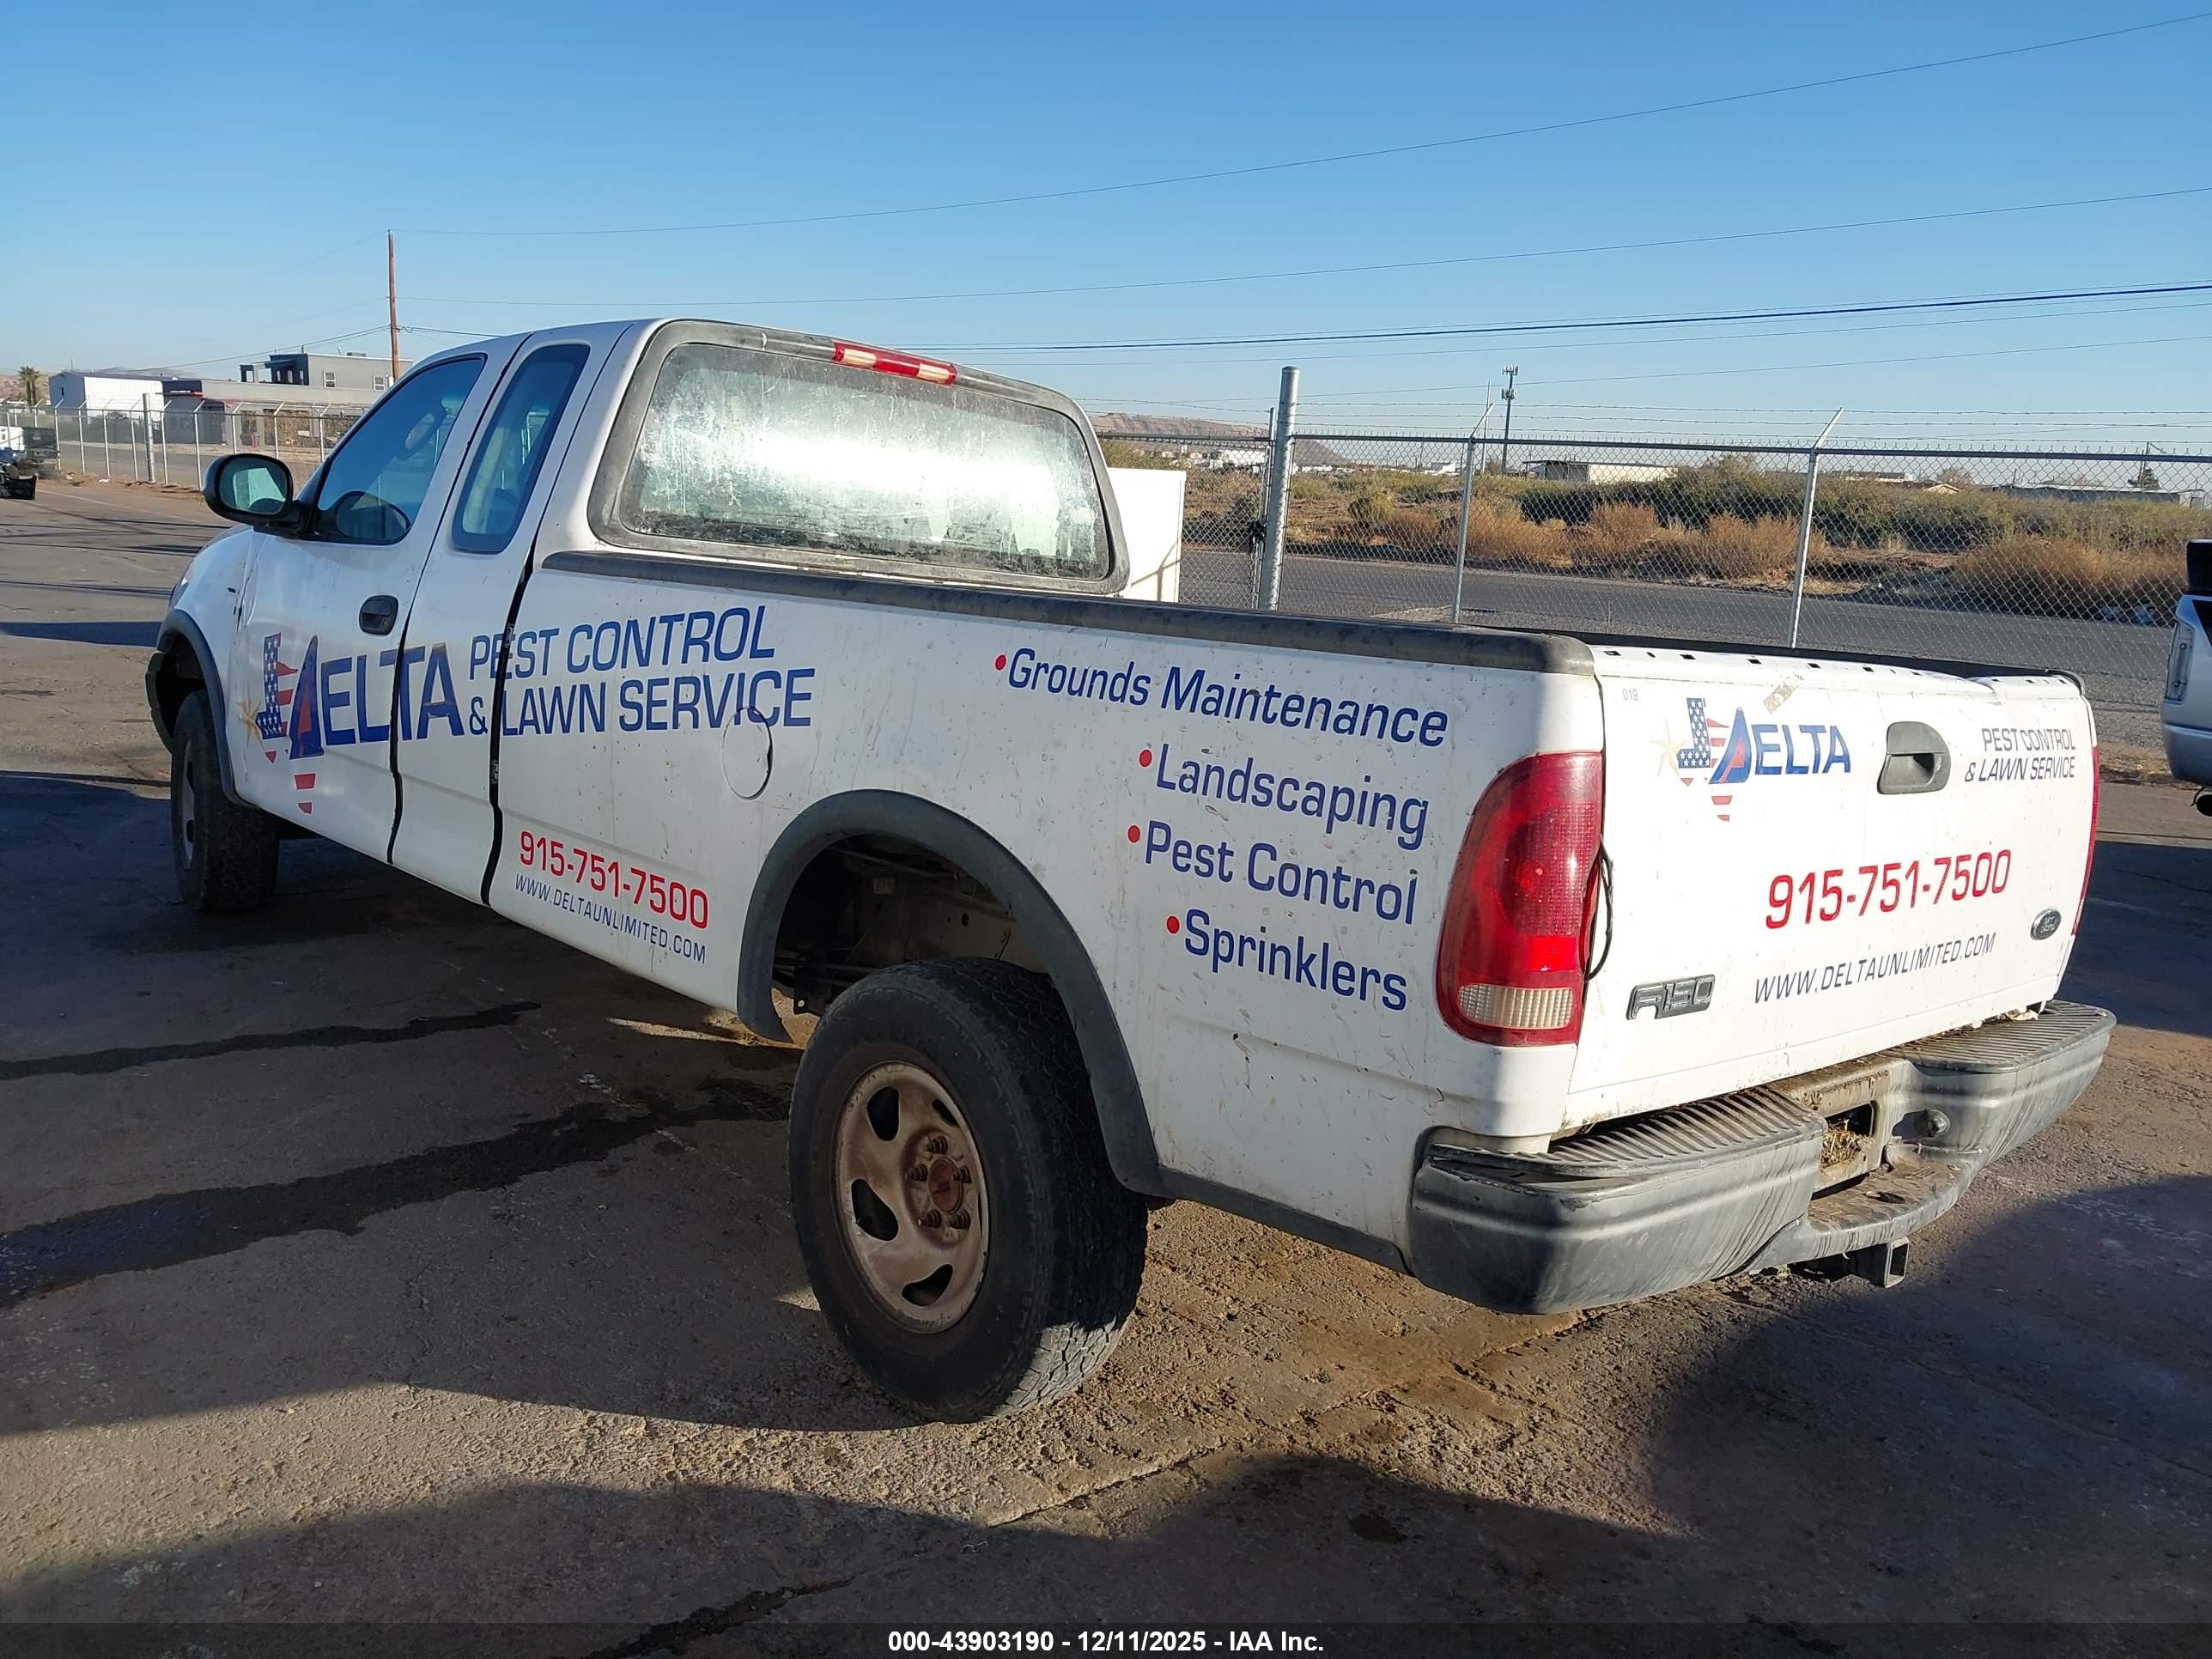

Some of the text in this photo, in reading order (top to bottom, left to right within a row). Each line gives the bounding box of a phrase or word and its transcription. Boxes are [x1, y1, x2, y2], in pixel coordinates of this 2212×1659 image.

[470, 605, 775, 680] PEST CONTROL
[469, 667, 816, 737] & LAWN SERVICE
[1008, 647, 1449, 747] Grounds Maintenance
[1981, 728, 2076, 751] PEST CONTROL
[1155, 743, 1430, 851] Landscaping
[1965, 757, 2075, 782] & LAWN SERVICE
[520, 830, 710, 930] 915-751-7500
[1145, 820, 1418, 925] Pest Control
[1765, 849, 2012, 929] 915-751-7500
[515, 872, 707, 964] WWW.DELTAUNLIMITED.COM
[1185, 908, 1407, 1012] Sprinklers
[1754, 932, 1996, 1003] WWW.DELTAUNLIMITED.COM
